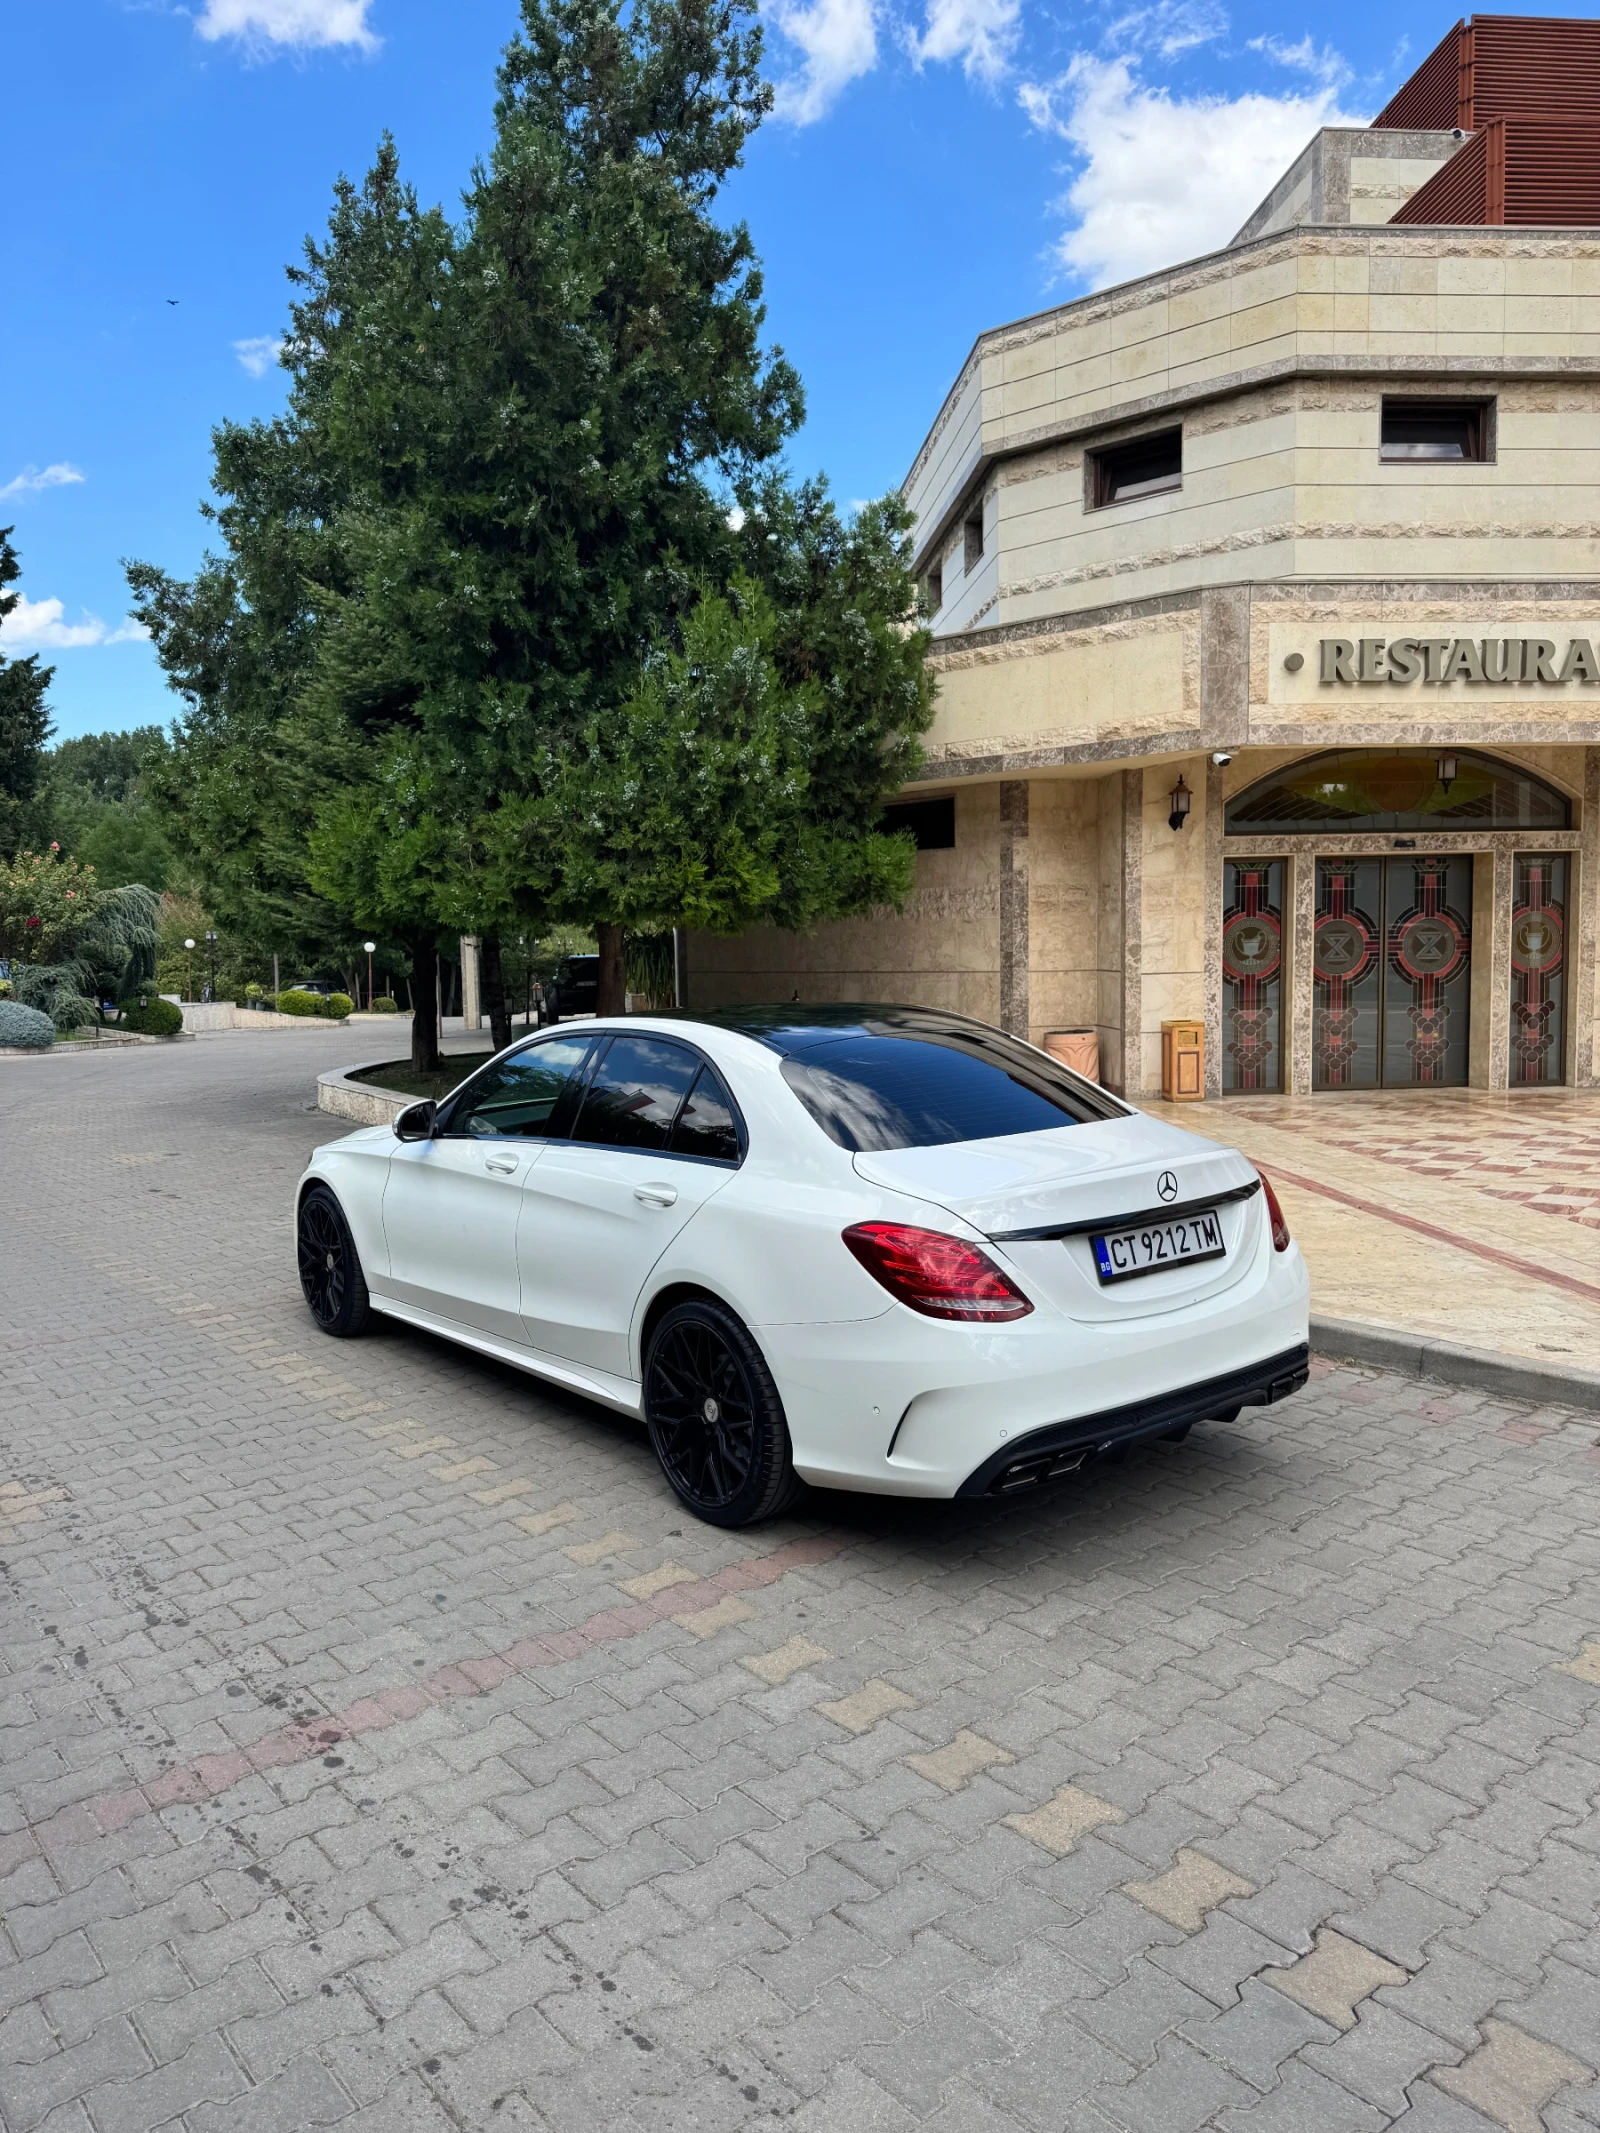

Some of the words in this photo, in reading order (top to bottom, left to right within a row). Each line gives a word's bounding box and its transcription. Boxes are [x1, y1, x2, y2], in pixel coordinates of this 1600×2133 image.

[1110, 1234, 1137, 1268] CT
[1141, 1224, 1190, 1261] 9212
[1189, 1217, 1218, 1249] TM
[1100, 1261, 1111, 1272] BG
